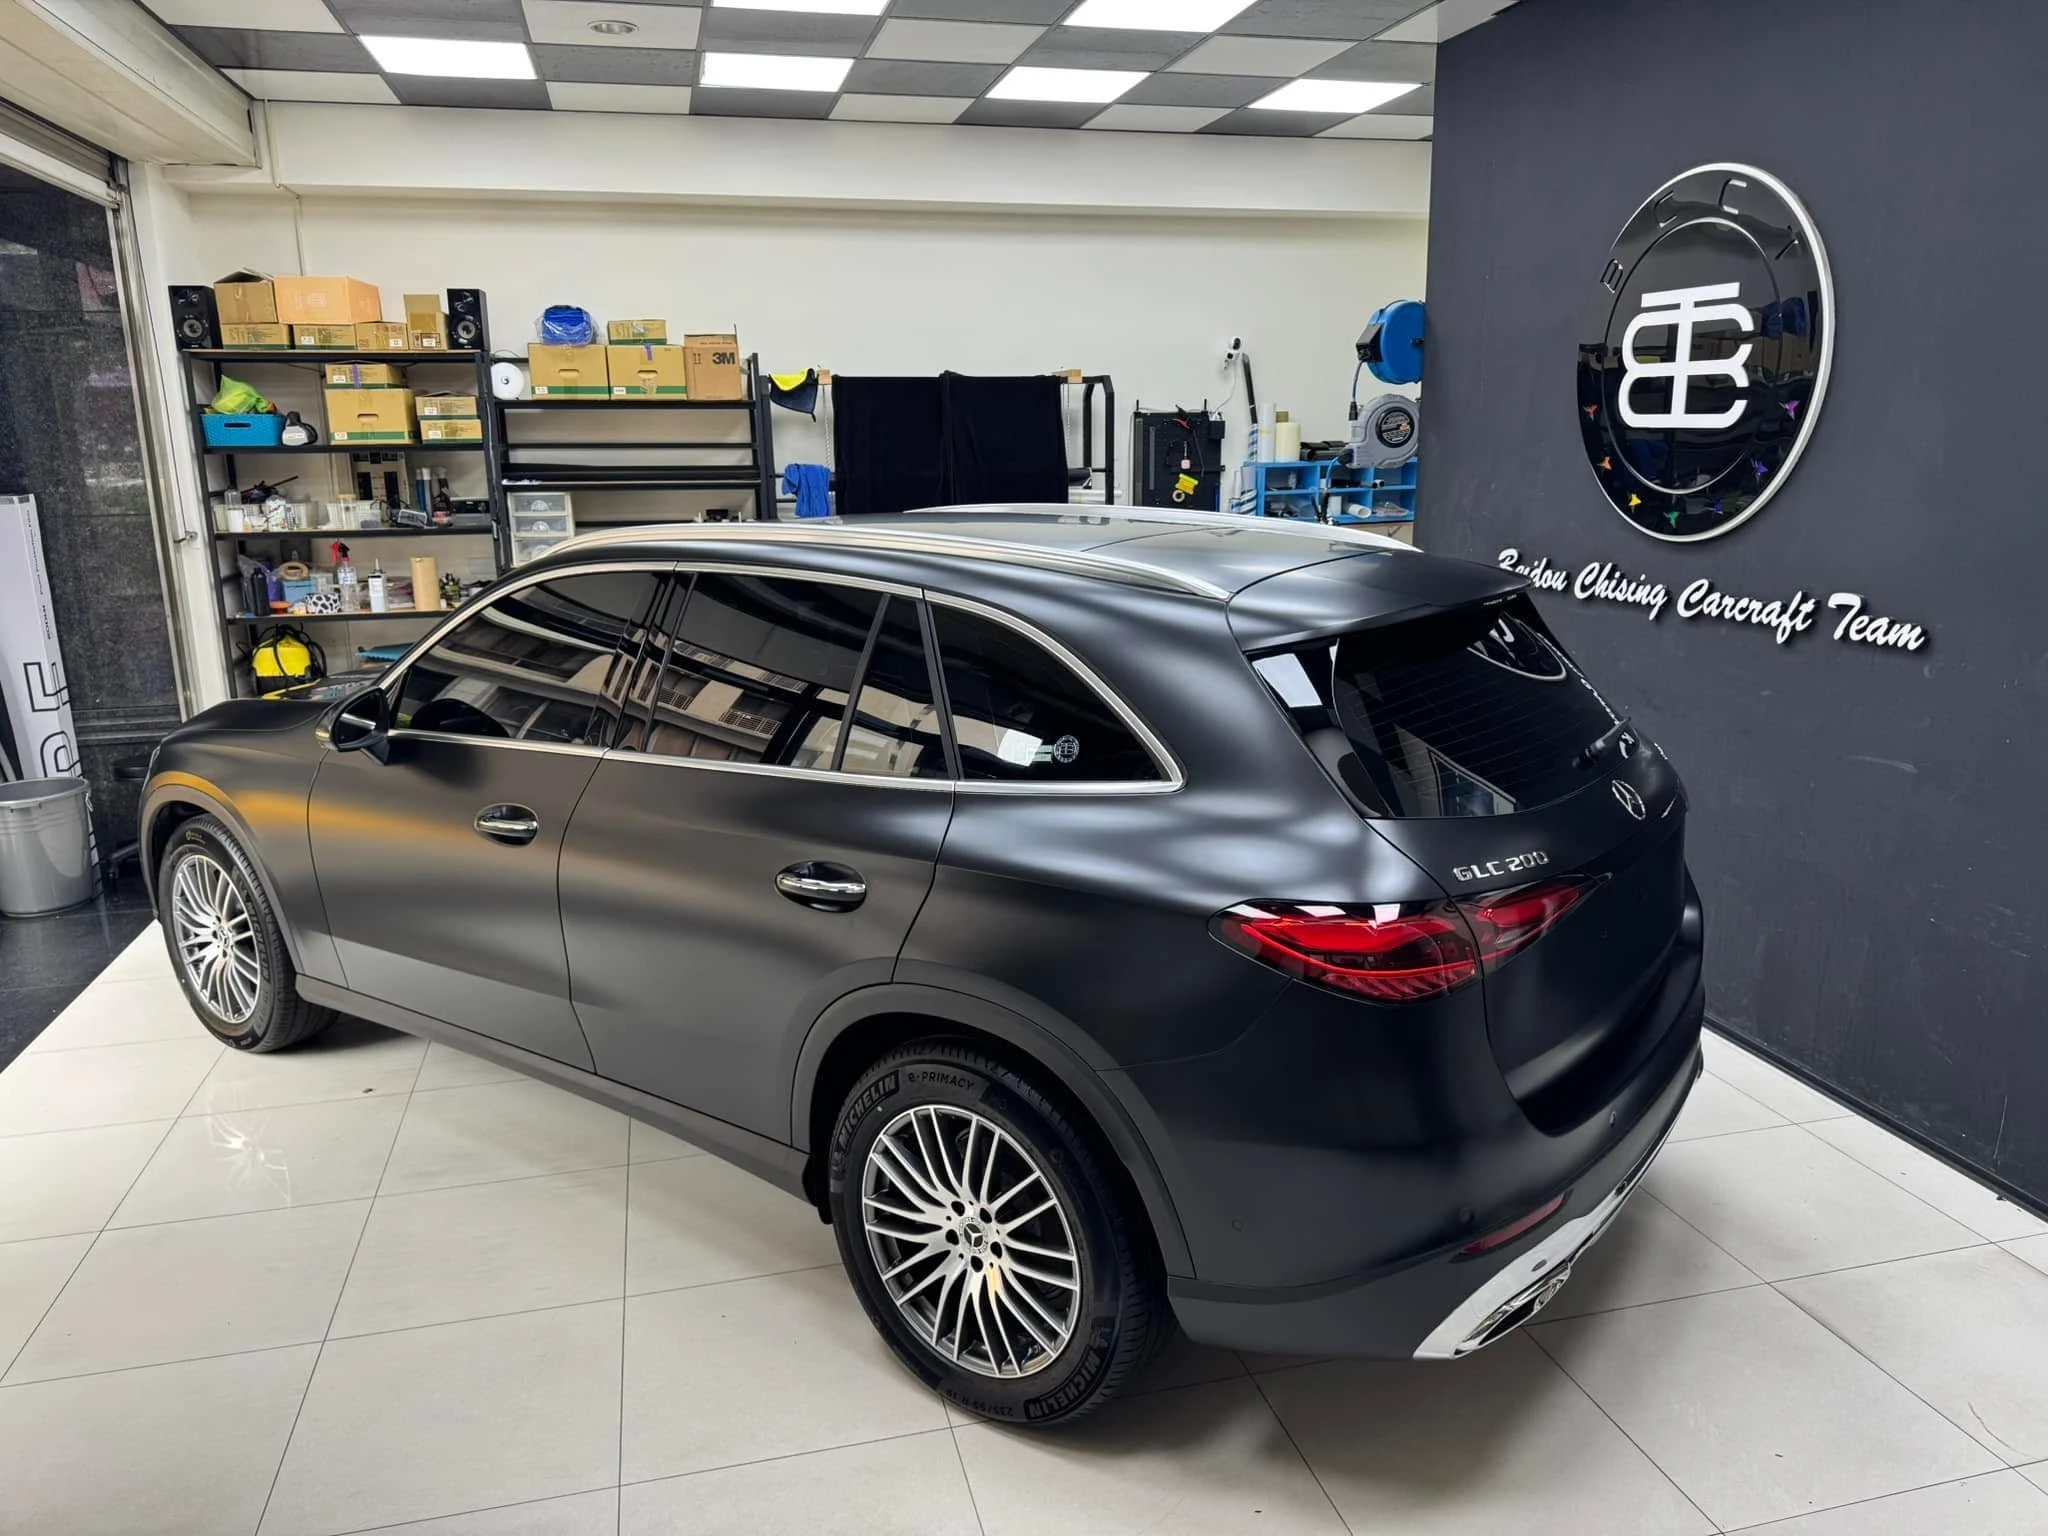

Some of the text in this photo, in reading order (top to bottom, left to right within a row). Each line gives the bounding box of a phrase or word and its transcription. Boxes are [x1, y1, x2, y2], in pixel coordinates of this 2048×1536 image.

[712, 352, 736, 365] 3M
[1574, 562, 1667, 621] Chising
[1677, 578, 1816, 644] Carcraft
[1828, 592, 1925, 650] Team
[1453, 851, 1550, 881] GLC 200
[837, 1073, 897, 1148] MICHELIN
[1028, 1349, 1100, 1418] MICHELIN
